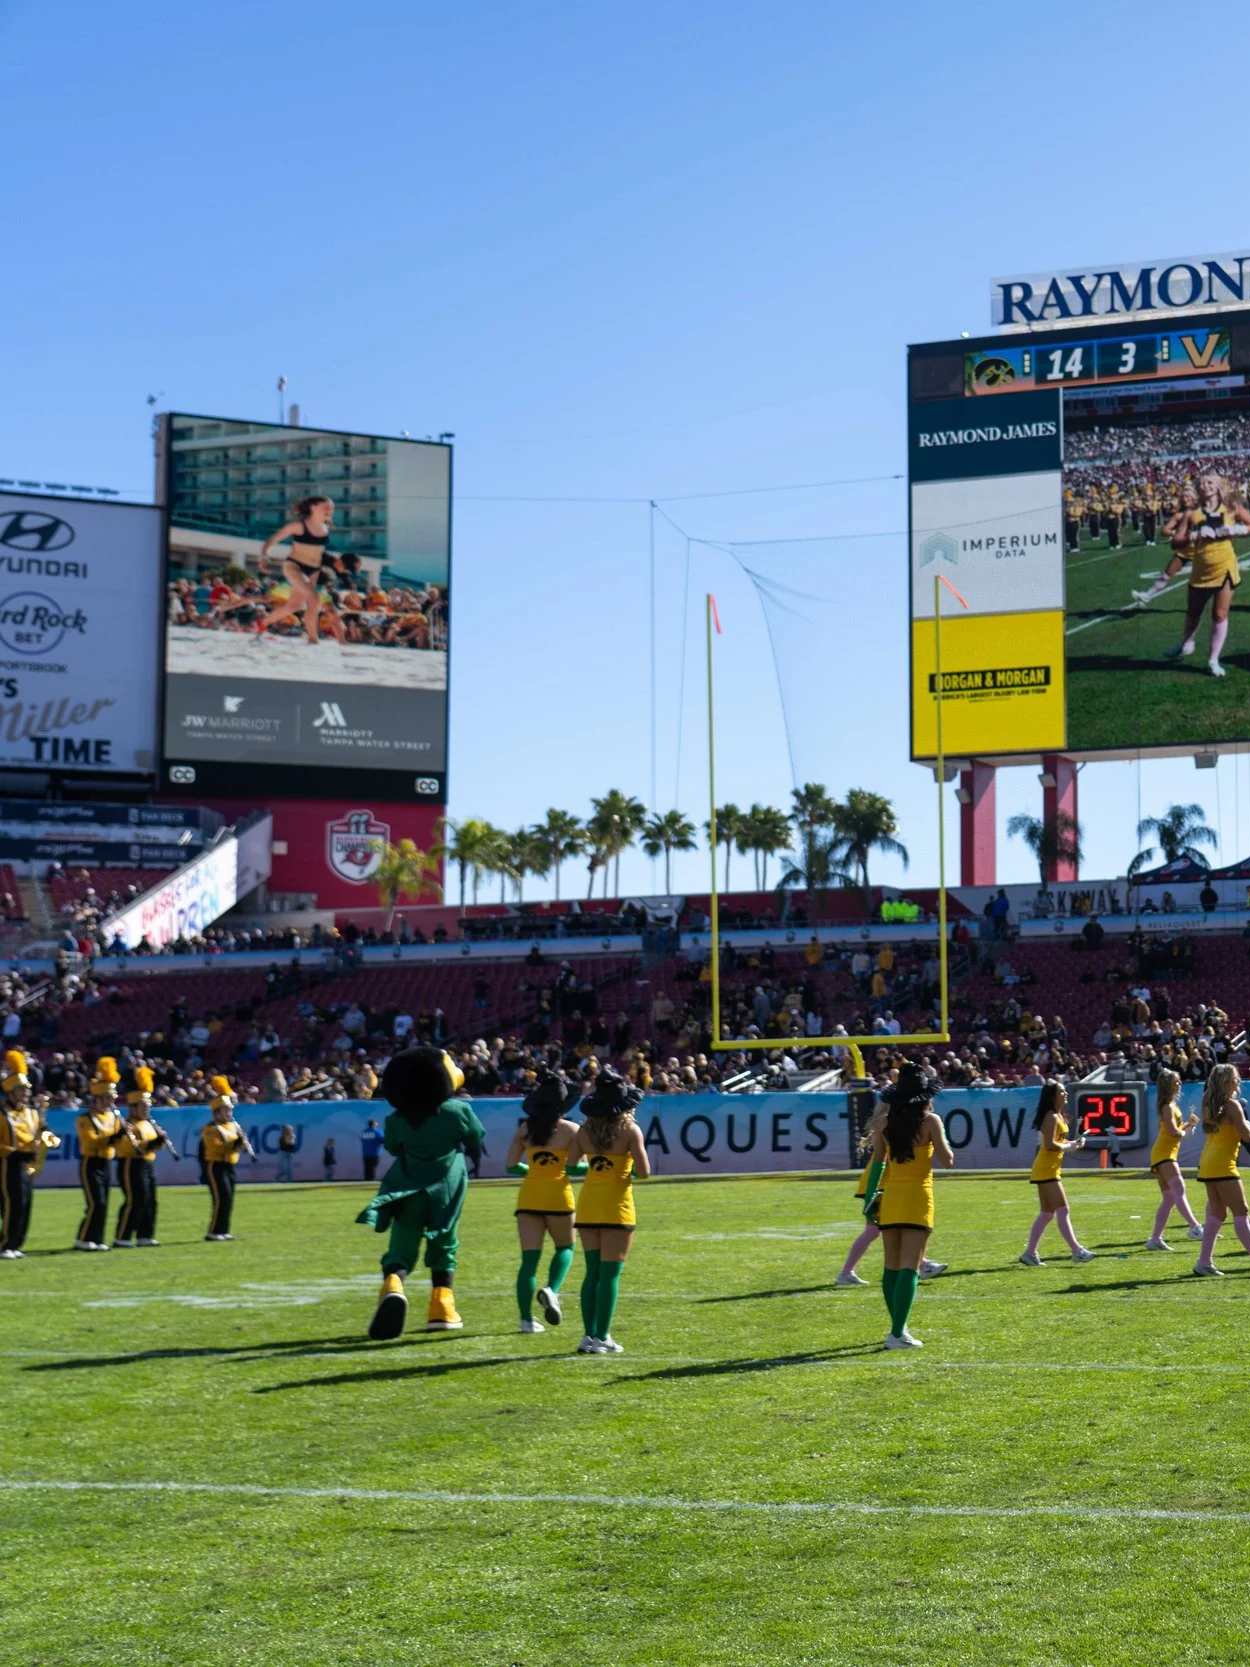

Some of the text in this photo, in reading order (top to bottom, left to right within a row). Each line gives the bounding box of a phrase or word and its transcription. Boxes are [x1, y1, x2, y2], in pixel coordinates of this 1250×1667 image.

[1047, 348, 1083, 380] 14
[1118, 342, 1136, 374] 3
[919, 421, 1057, 448] RAYMOND JAMES
[963, 532, 1057, 551] IMPERIUM
[995, 549, 1026, 559] DATA
[31, 606, 88, 635] Rock
[15, 632, 43, 643] BET
[985, 673, 993, 687] &
[995, 669, 1045, 687] MORGAN
[208, 716, 281, 731] MARRIOTT
[320, 728, 373, 738] MARRIOTT
[30, 737, 112, 765] TIME
[321, 737, 431, 751] TAMPA WATER STREET
[1083, 1097, 1130, 1134] 25
[944, 1107, 1027, 1149] OW
